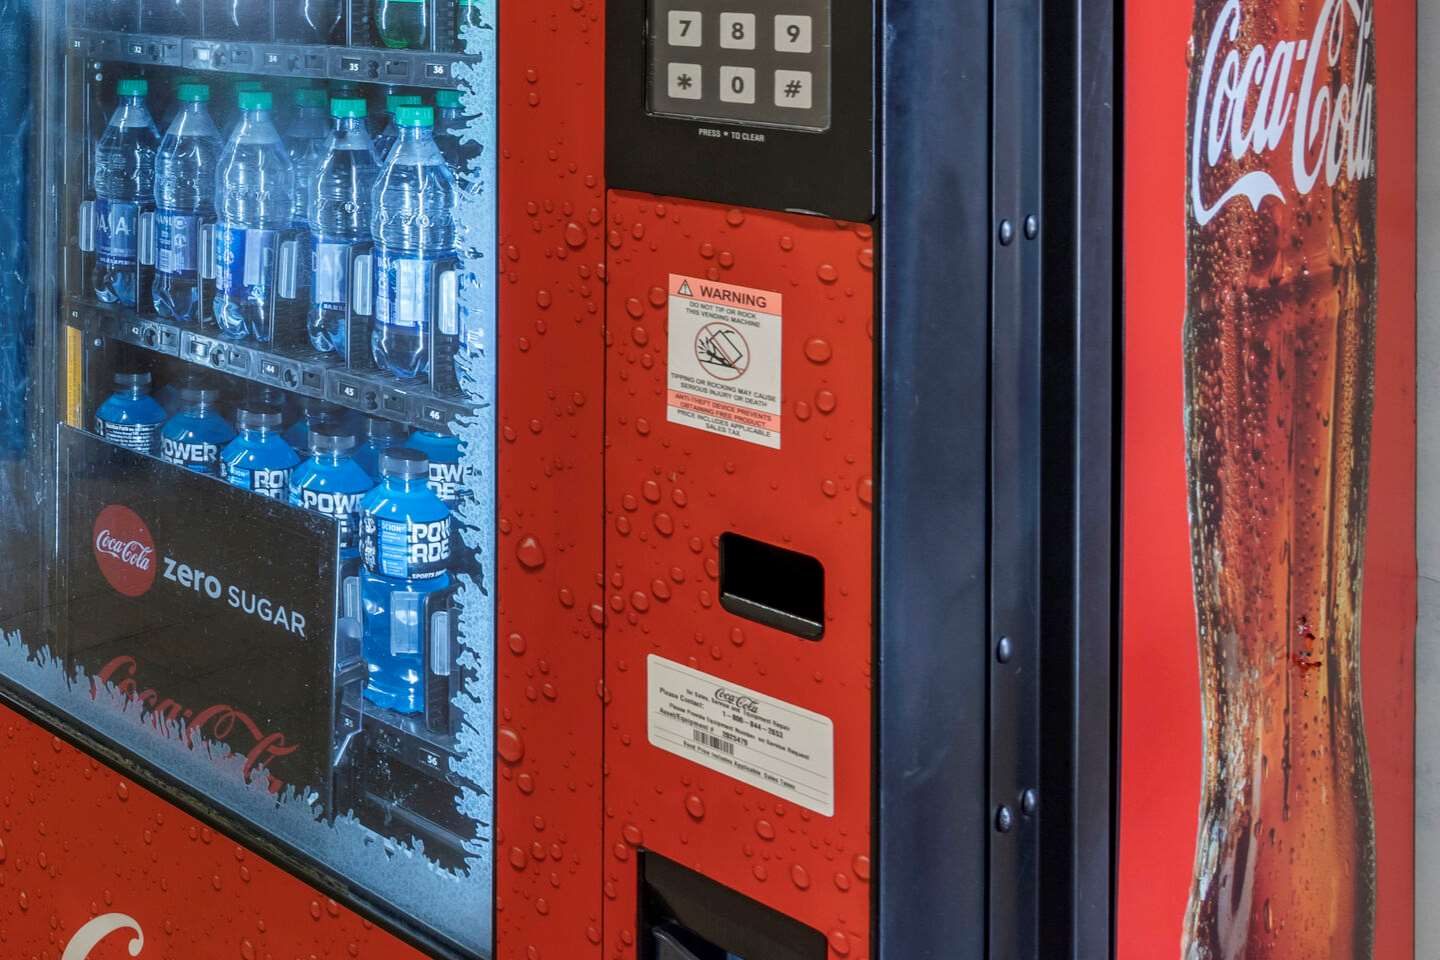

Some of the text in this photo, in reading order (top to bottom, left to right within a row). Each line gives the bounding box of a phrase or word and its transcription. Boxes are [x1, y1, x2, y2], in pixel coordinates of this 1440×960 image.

[679, 20, 800, 43] 7 8 9
[349, 62, 359, 72] 35
[433, 64, 444, 74] 36
[732, 76, 802, 98] 0 #
[698, 128, 765, 142] PRESS TO CLEAR
[700, 285, 767, 308] WARNING
[686, 308, 761, 328] THIS VENDING MACHINE
[700, 303, 713, 311] NOT
[737, 310, 756, 319] ROCK
[265, 364, 275, 373] 44
[344, 386, 355, 397] 45
[429, 410, 440, 420] 46
[671, 372, 695, 383] TIPPING
[707, 381, 736, 393] ROCKING
[753, 391, 776, 402] CAUSE
[163, 438, 217, 463] OWER
[96, 529, 154, 571] Coca-Cola
[163, 556, 307, 638] zero SUGAR
[715, 688, 760, 714] Coca-Cola
